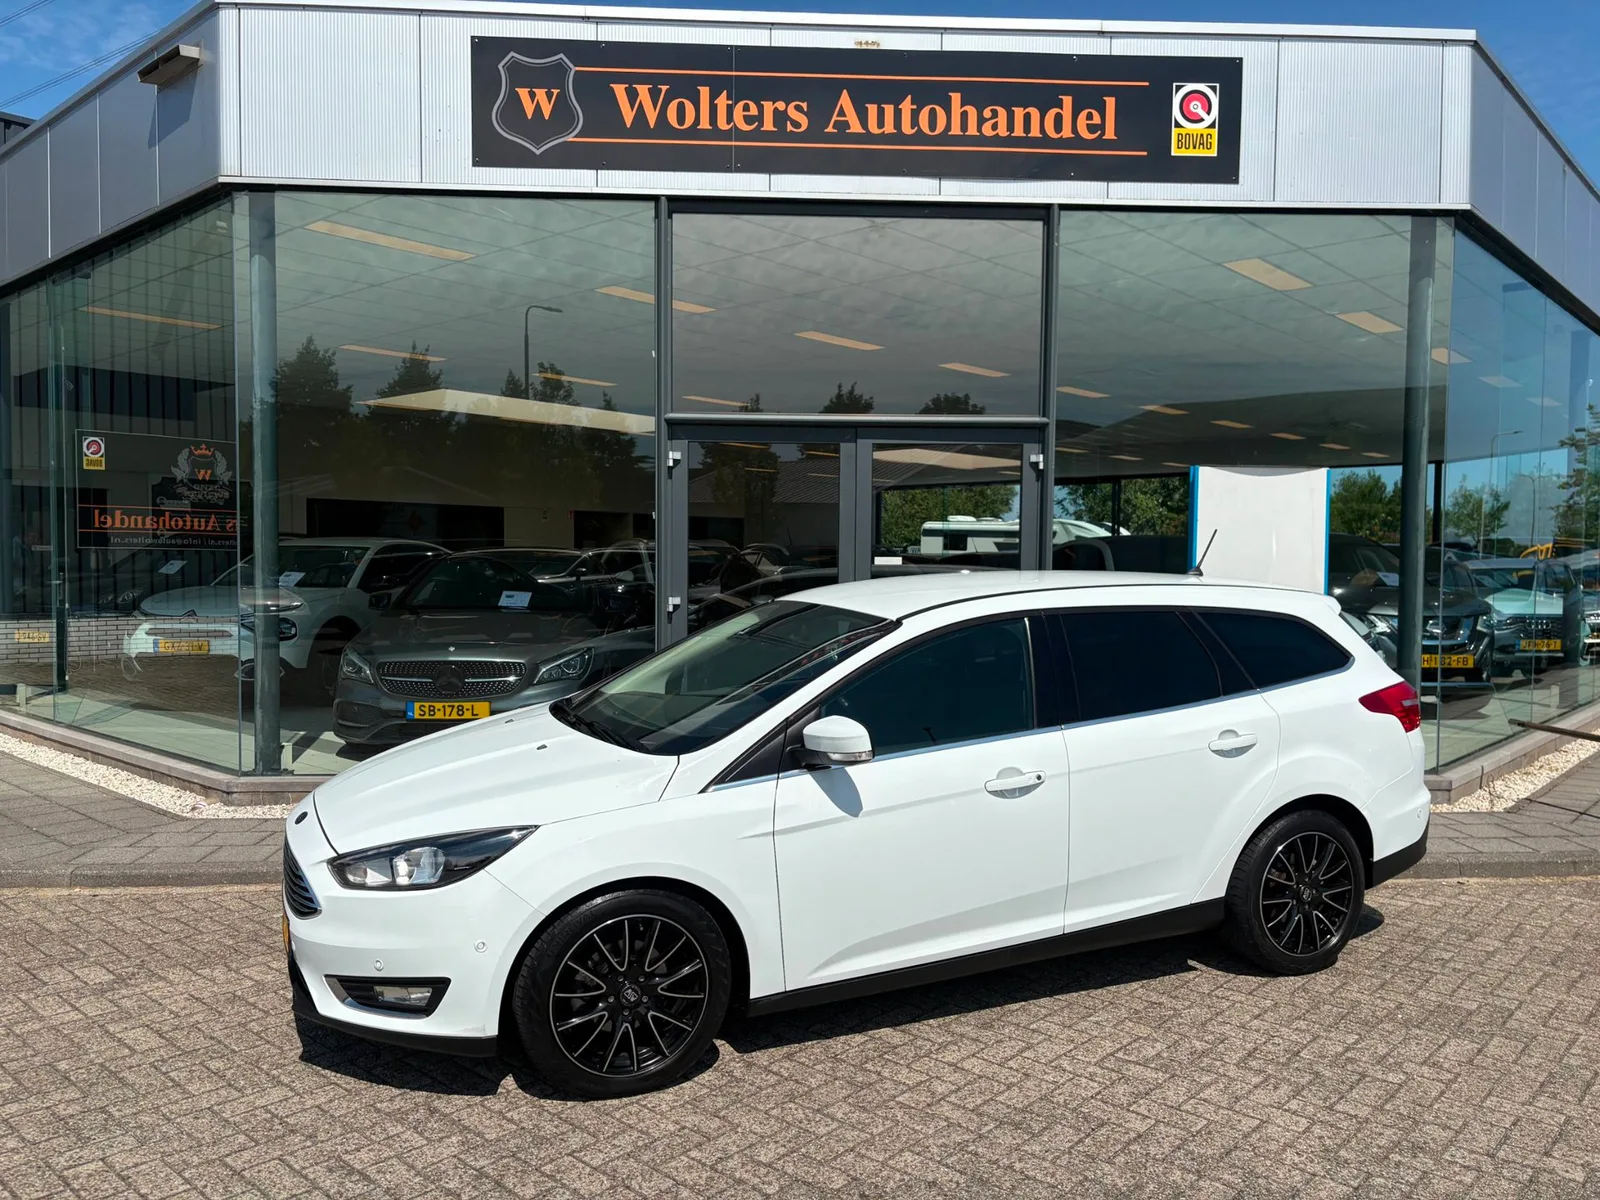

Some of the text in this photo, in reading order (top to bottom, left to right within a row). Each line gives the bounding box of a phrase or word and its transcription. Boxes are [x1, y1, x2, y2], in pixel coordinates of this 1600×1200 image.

[515, 88, 560, 120] W
[609, 83, 1118, 140] Wolters Autohandel
[1177, 132, 1213, 151] BOVAG
[418, 704, 479, 717] SB-178-L
